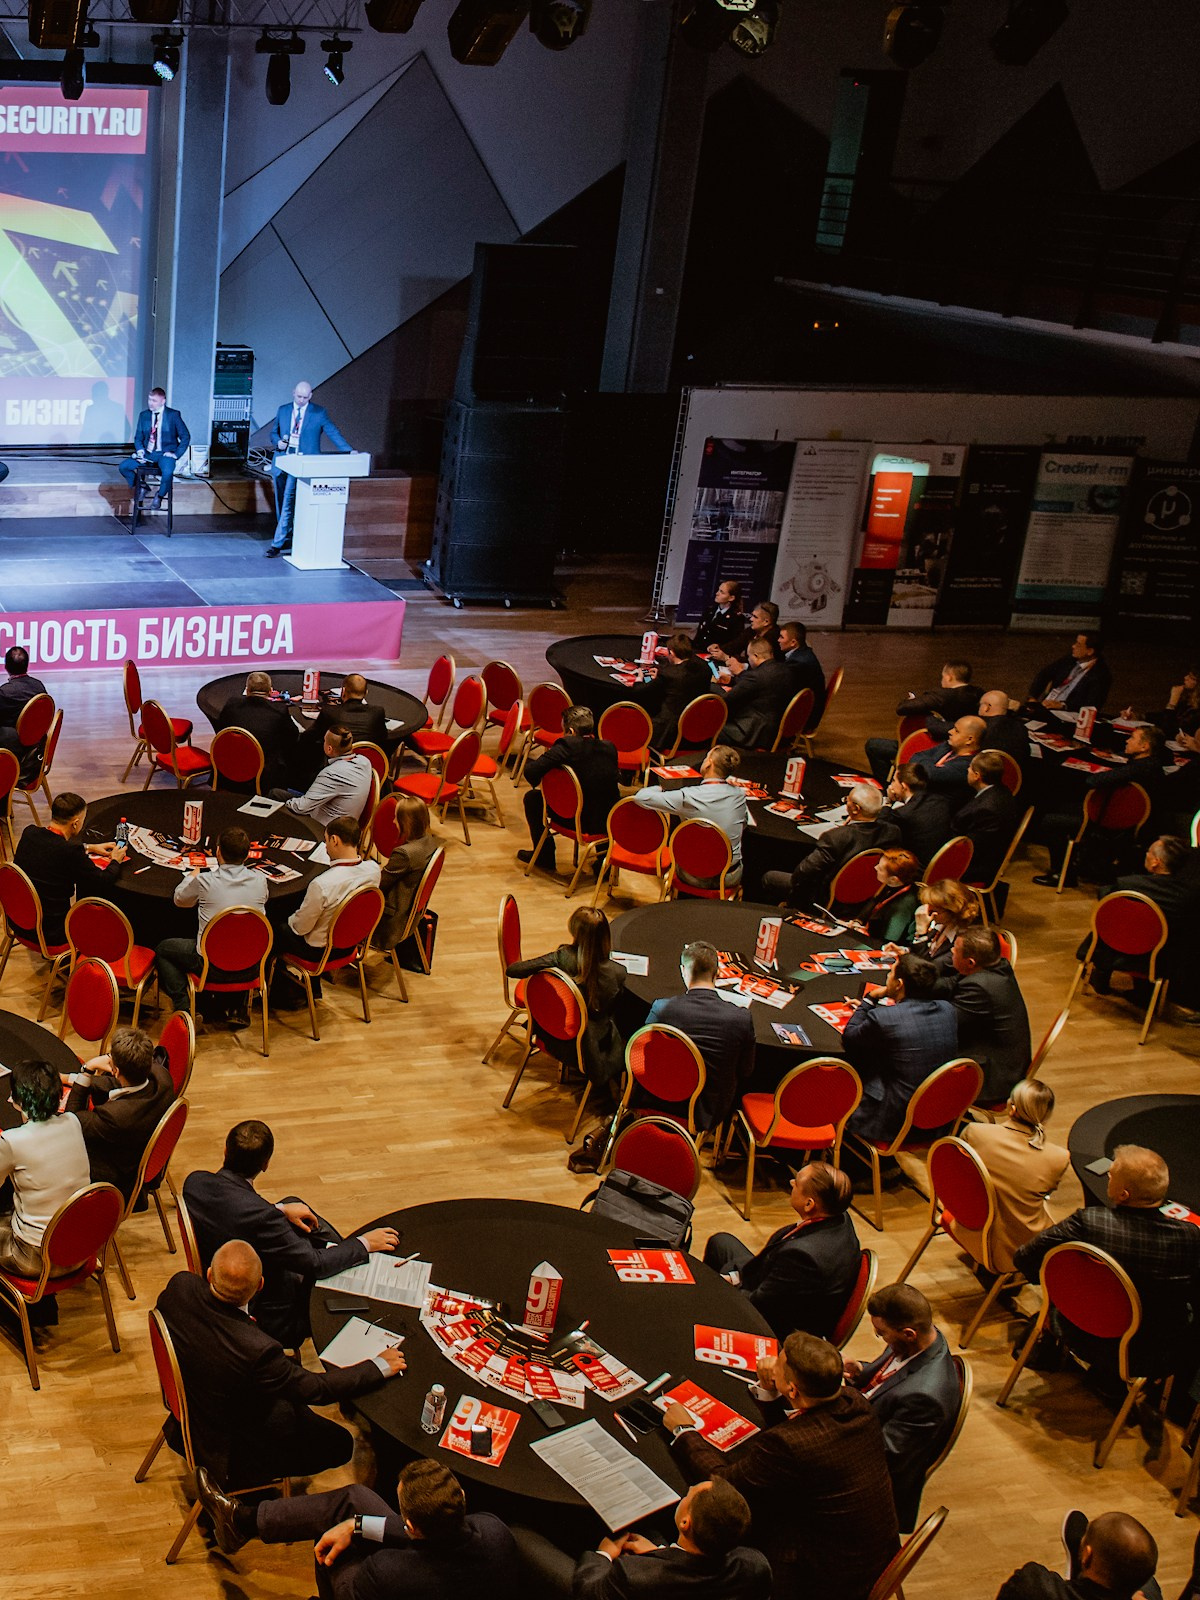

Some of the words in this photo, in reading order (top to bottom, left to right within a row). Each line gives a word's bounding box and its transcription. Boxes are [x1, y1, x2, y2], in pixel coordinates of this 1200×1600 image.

[1045, 460, 1130, 475] Credinfrm
[138, 613, 294, 659] БИЗНЕСА
[525, 1276, 550, 1314] 9
[695, 1347, 748, 1370] 9
[450, 1394, 482, 1431] 9
